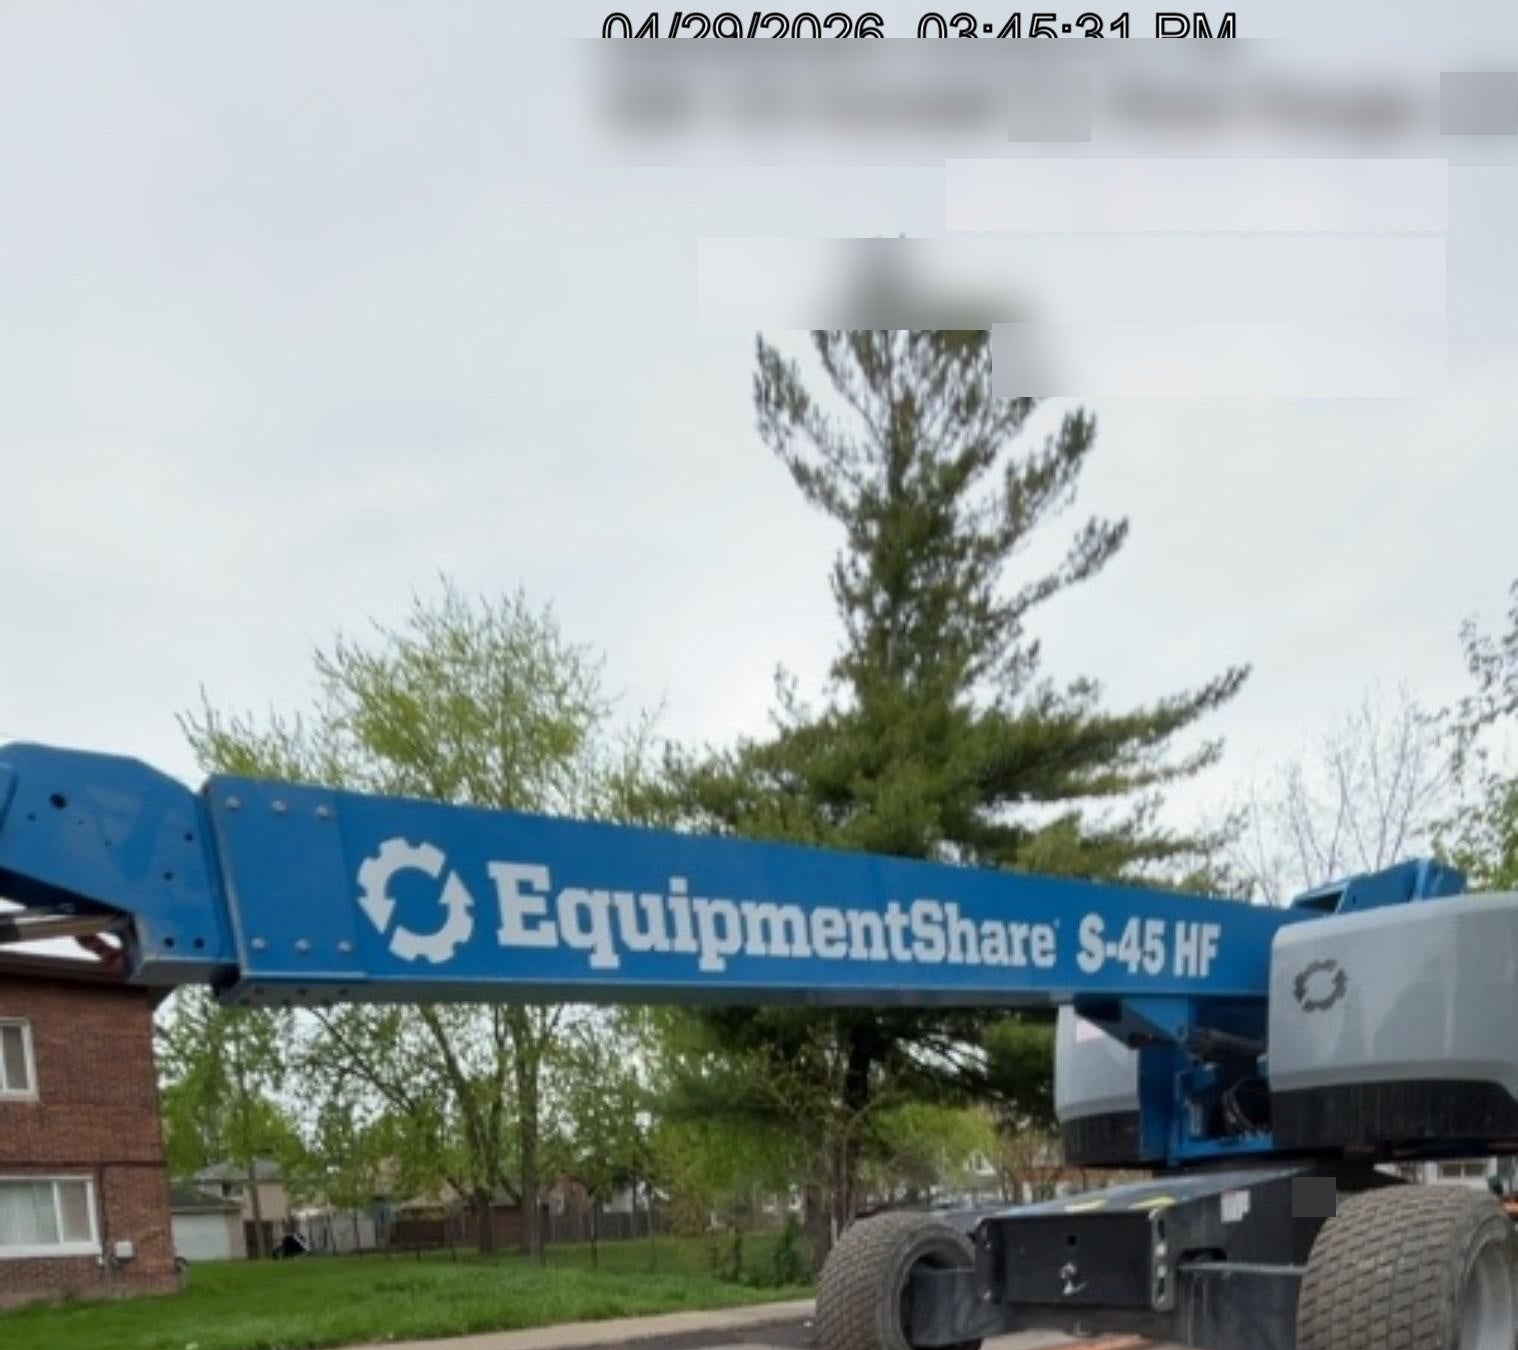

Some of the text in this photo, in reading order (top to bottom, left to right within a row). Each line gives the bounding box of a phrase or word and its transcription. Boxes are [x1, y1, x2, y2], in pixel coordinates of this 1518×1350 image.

[487, 860, 1222, 978] EquipmentShare S-45 HF
